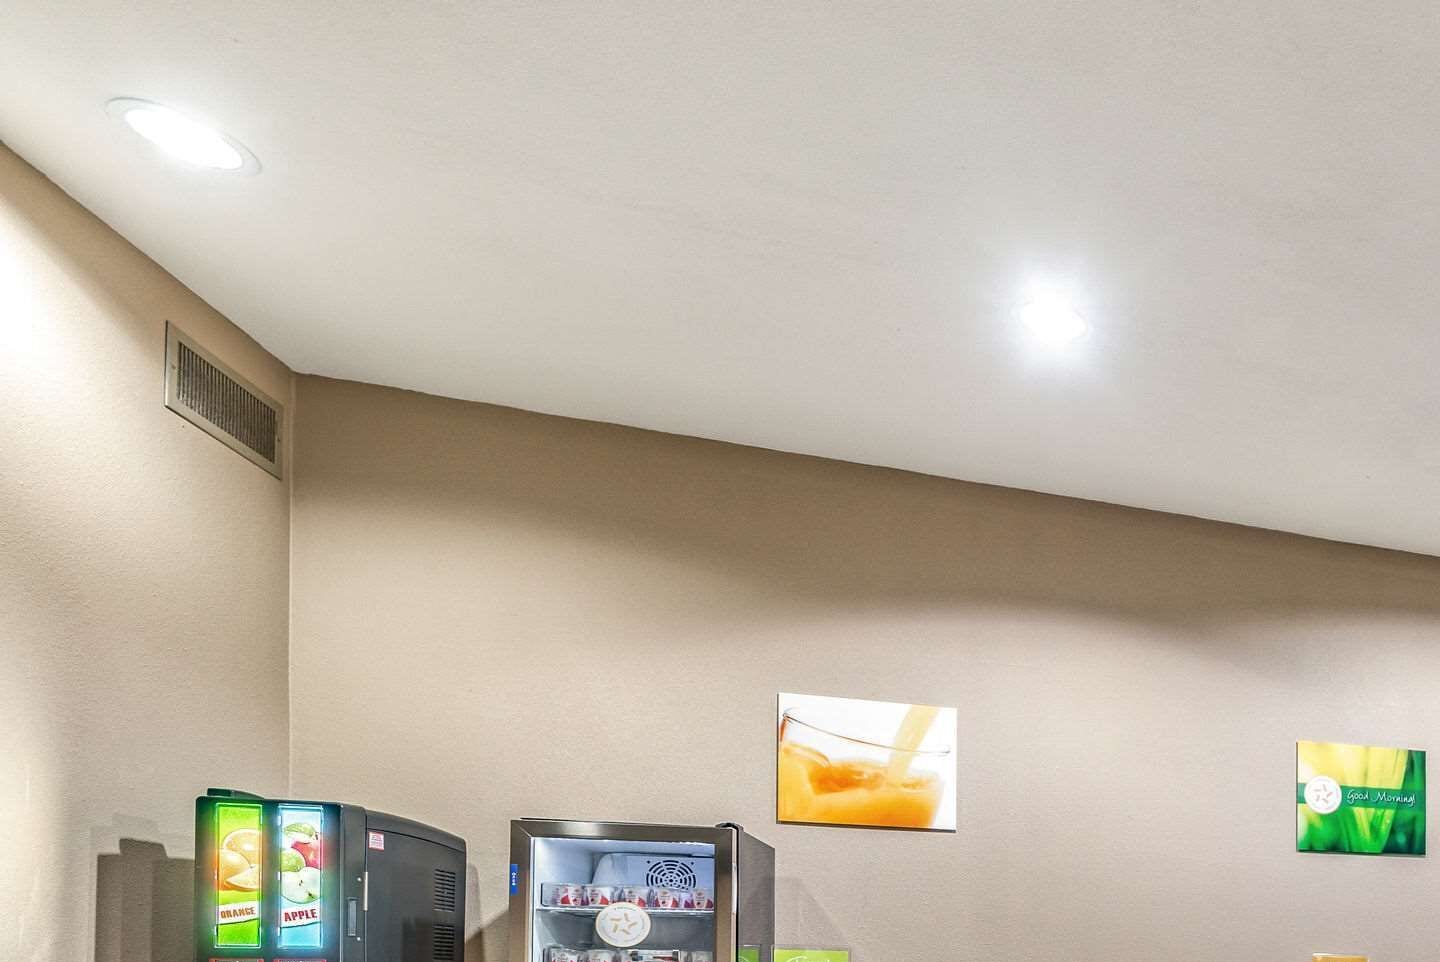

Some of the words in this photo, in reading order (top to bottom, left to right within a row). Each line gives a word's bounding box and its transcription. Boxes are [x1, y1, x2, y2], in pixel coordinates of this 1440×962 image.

[1347, 789, 1369, 804] Good
[220, 906, 256, 919] ORANGE
[284, 908, 318, 922] APPLE
